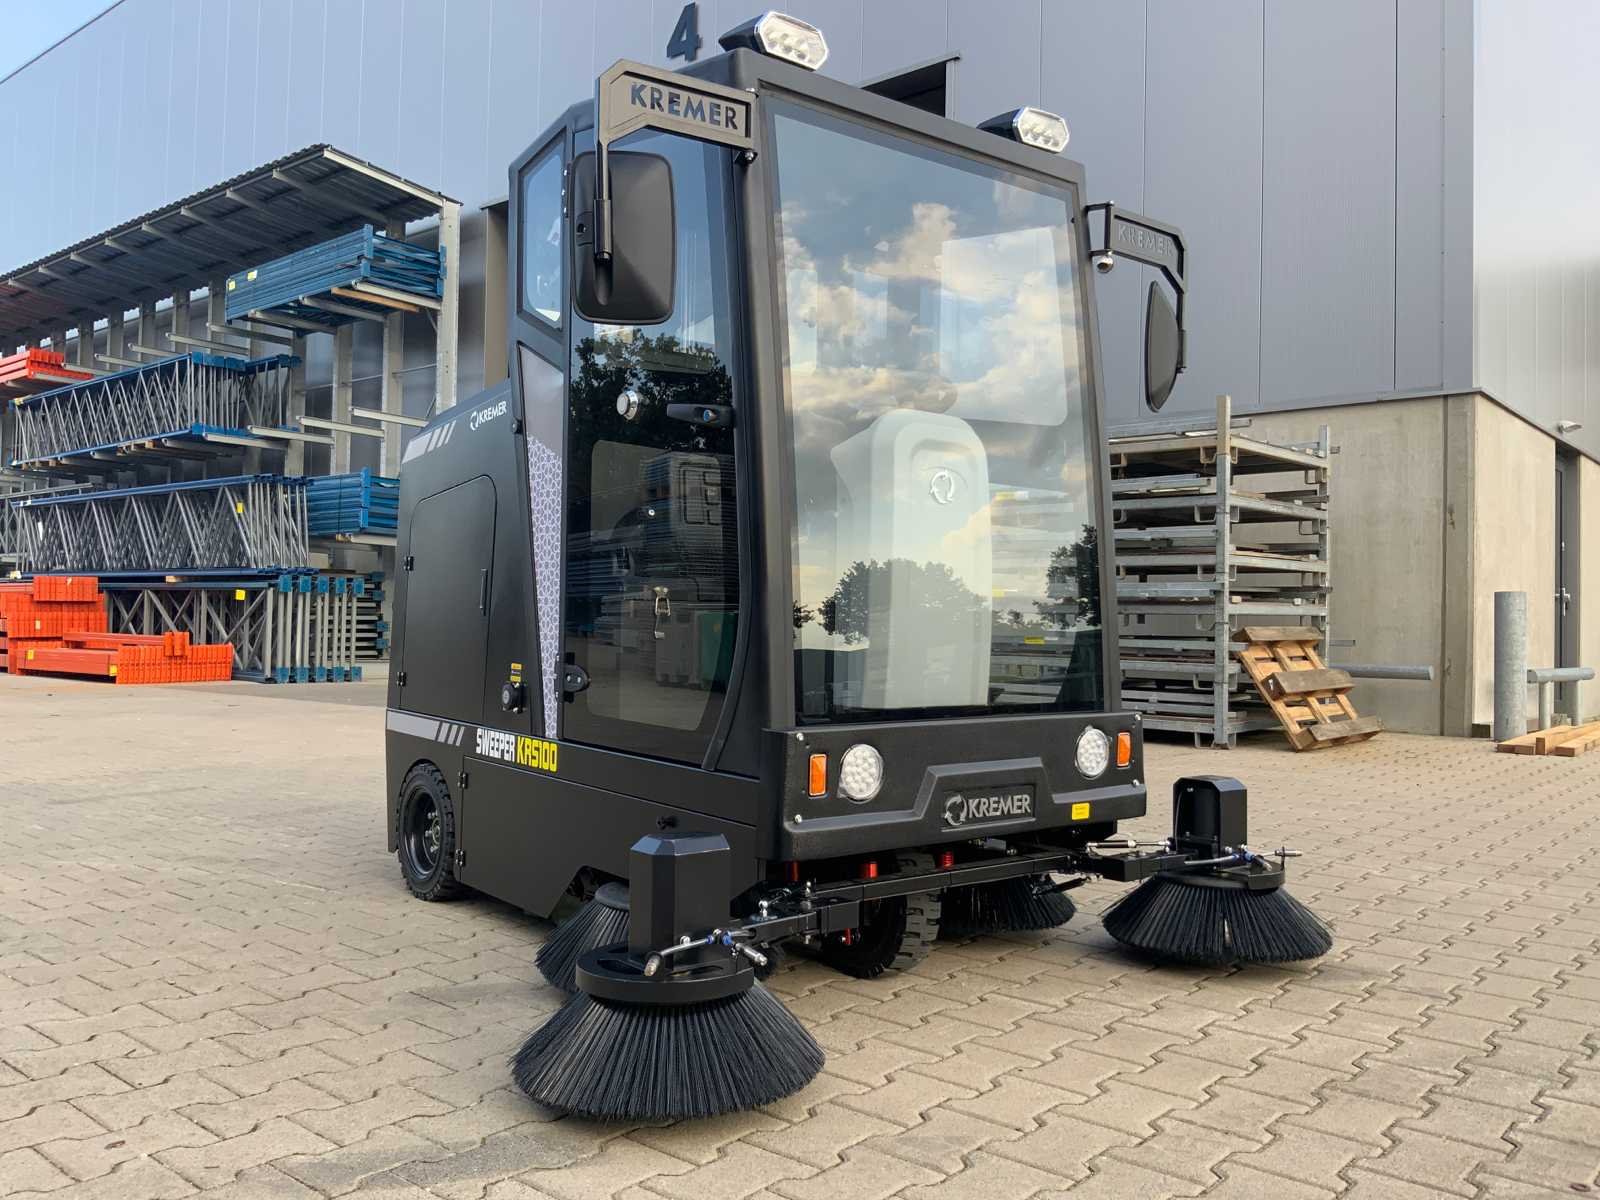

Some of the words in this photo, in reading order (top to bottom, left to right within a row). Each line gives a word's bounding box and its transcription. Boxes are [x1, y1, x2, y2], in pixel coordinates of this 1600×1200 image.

[666, 2, 702, 62] 4
[630, 82, 738, 130] KREMER
[1118, 224, 1174, 256] KREMER
[479, 401, 507, 424] KREMER
[476, 728, 516, 763] SWEEPER
[968, 794, 1031, 818] KREMER
